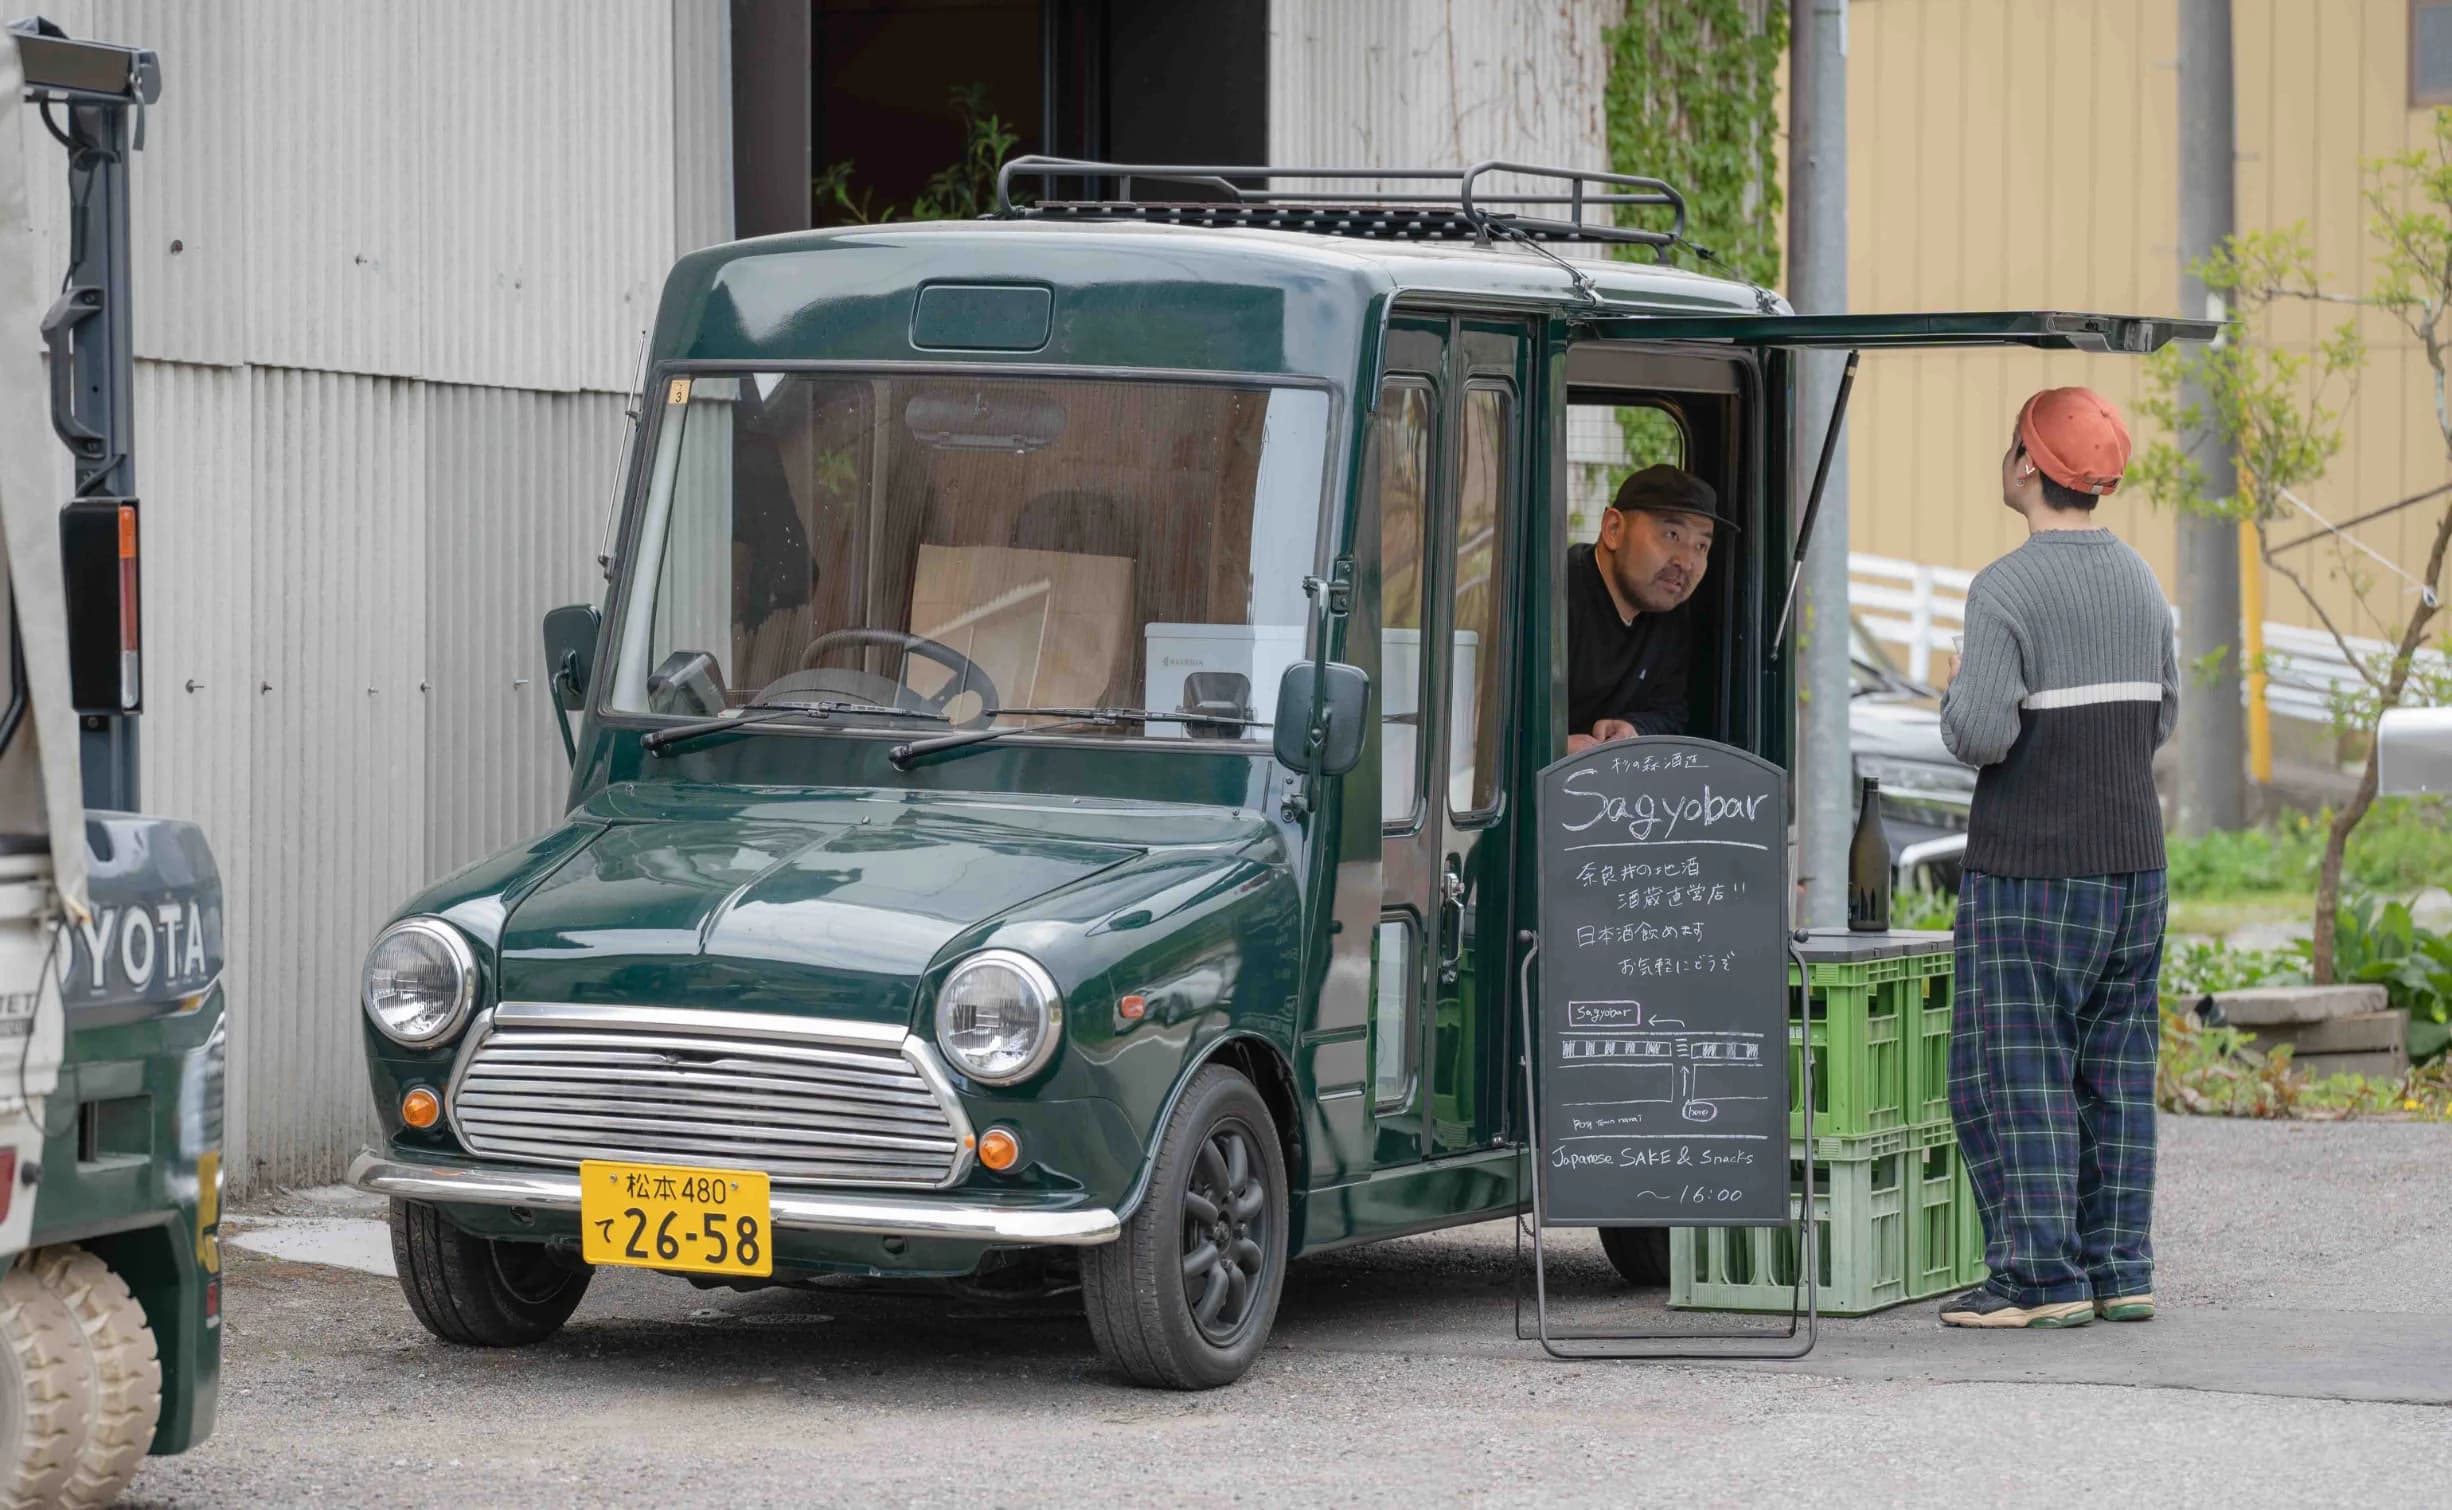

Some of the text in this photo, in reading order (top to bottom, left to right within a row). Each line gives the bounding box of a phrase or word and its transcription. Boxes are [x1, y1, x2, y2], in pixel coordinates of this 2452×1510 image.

[1562, 768, 1768, 840] Sagyobar
[1576, 857, 1701, 888] 奈良井の地酒
[1576, 921, 1705, 949] 日本酒飲めます
[1617, 951, 1736, 977] お気軽にどうぞ
[1576, 1006, 1632, 1023] Sagyobar
[1552, 1145, 1753, 1171] Japanese SAKE & Snacks
[594, 1207, 760, 1266] て 26-58
